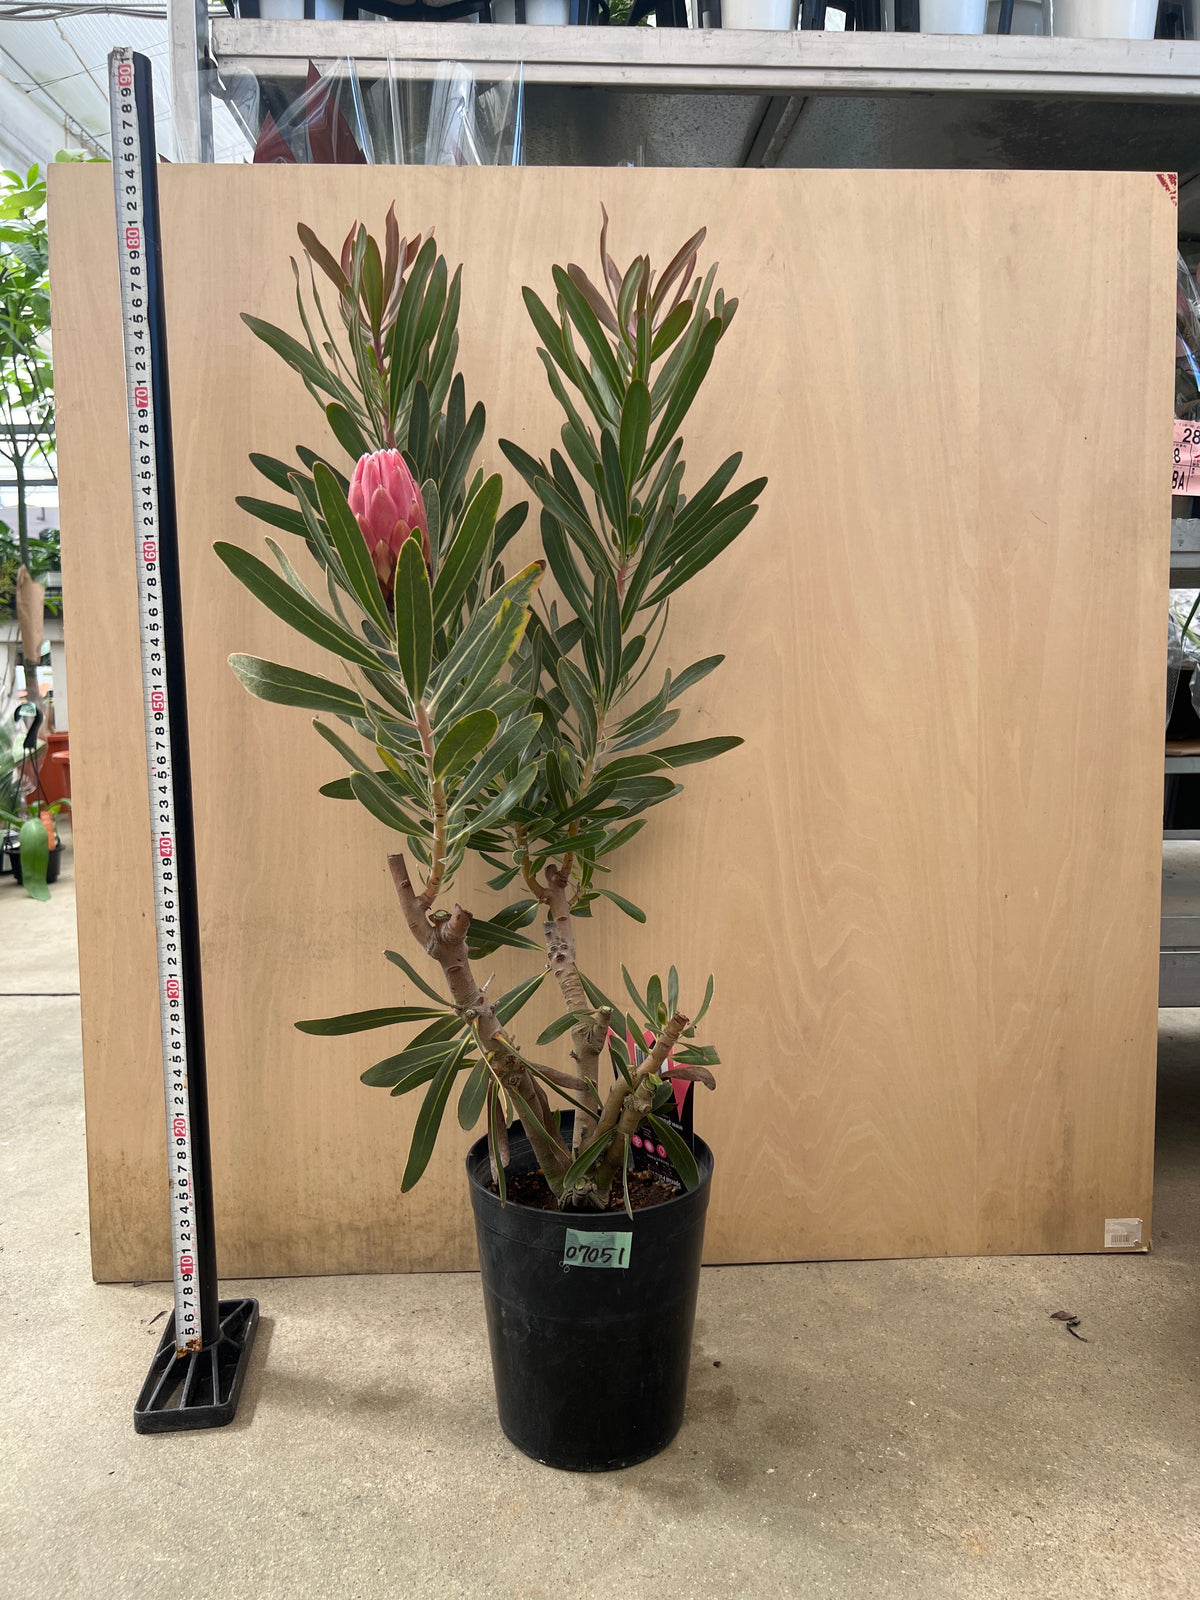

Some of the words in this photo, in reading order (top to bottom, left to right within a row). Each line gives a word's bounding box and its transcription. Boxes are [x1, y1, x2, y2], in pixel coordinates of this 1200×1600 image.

[120, 68, 130, 84] 90
[120, 87, 131, 97] 9
[121, 103, 131, 113] 8
[122, 120, 132, 129] 7
[123, 136, 133, 146] 6
[123, 152, 134, 162] 5
[124, 168, 135, 178] 4
[125, 185, 136, 195] 3
[126, 201, 137, 211] 2
[127, 230, 139, 246] 80
[129, 250, 139, 259] 9
[129, 265, 140, 275] 8
[130, 282, 141, 291] 7
[131, 297, 142, 308] 6
[132, 313, 143, 323] 5
[133, 329, 144, 339] 4
[134, 345, 145, 355] 3
[135, 361, 145, 371] 2
[136, 389, 147, 405] 70
[137, 408, 148, 418] 9
[138, 424, 148, 433] 8
[139, 439, 149, 449] 7
[139, 454, 150, 464] 6
[140, 470, 151, 479] 5
[141, 485, 151, 495] 4
[142, 501, 152, 510] 3
[143, 516, 153, 525] 2
[145, 544, 155, 559] 60
[145, 562, 156, 571] 9
[146, 577, 156, 586] 8
[147, 592, 157, 601] 7
[148, 607, 158, 617] 6
[149, 622, 159, 631] 5
[149, 637, 159, 646] 4
[150, 652, 160, 661] 3
[151, 667, 161, 676] 2
[153, 694, 163, 708] 50
[153, 711, 164, 721] 9
[154, 726, 164, 735] 8
[155, 741, 165, 750] 7
[156, 755, 166, 764] 6
[157, 770, 167, 779] 5
[158, 784, 167, 794] 4
[158, 799, 169, 808] 3
[159, 814, 169, 822] 2
[161, 840, 172, 854] 40
[161, 857, 171, 866] 9
[162, 871, 172, 880] 8
[163, 886, 173, 894] 7
[164, 900, 174, 909] 6
[165, 914, 174, 922] 5
[165, 928, 175, 937] 4
[166, 943, 176, 951] 3
[166, 957, 177, 965] 2
[168, 982, 178, 996] 30
[169, 999, 179, 1007] 9
[169, 1013, 180, 1022] 8
[170, 1027, 180, 1035] 7
[171, 1041, 181, 1049] 6
[172, 1055, 181, 1063] 5
[172, 1068, 182, 1077] 4
[173, 1082, 183, 1091] 3
[173, 1096, 183, 1104] 2
[175, 1120, 185, 1134] 20
[175, 1137, 186, 1146] 9
[176, 1151, 186, 1159] 8
[177, 1164, 187, 1173] 7
[177, 1178, 188, 1186] 6
[178, 1192, 188, 1200] 5
[179, 1205, 189, 1214] 4
[179, 1219, 190, 1227] 3
[181, 1233, 191, 1241] 2
[566, 1245, 625, 1265] 07051
[182, 1258, 192, 1271] 10
[181, 1274, 192, 1282] 9
[183, 1286, 193, 1294] 8
[183, 1300, 193, 1308] 7
[184, 1314, 194, 1322] 6
[185, 1327, 195, 1335] 5
